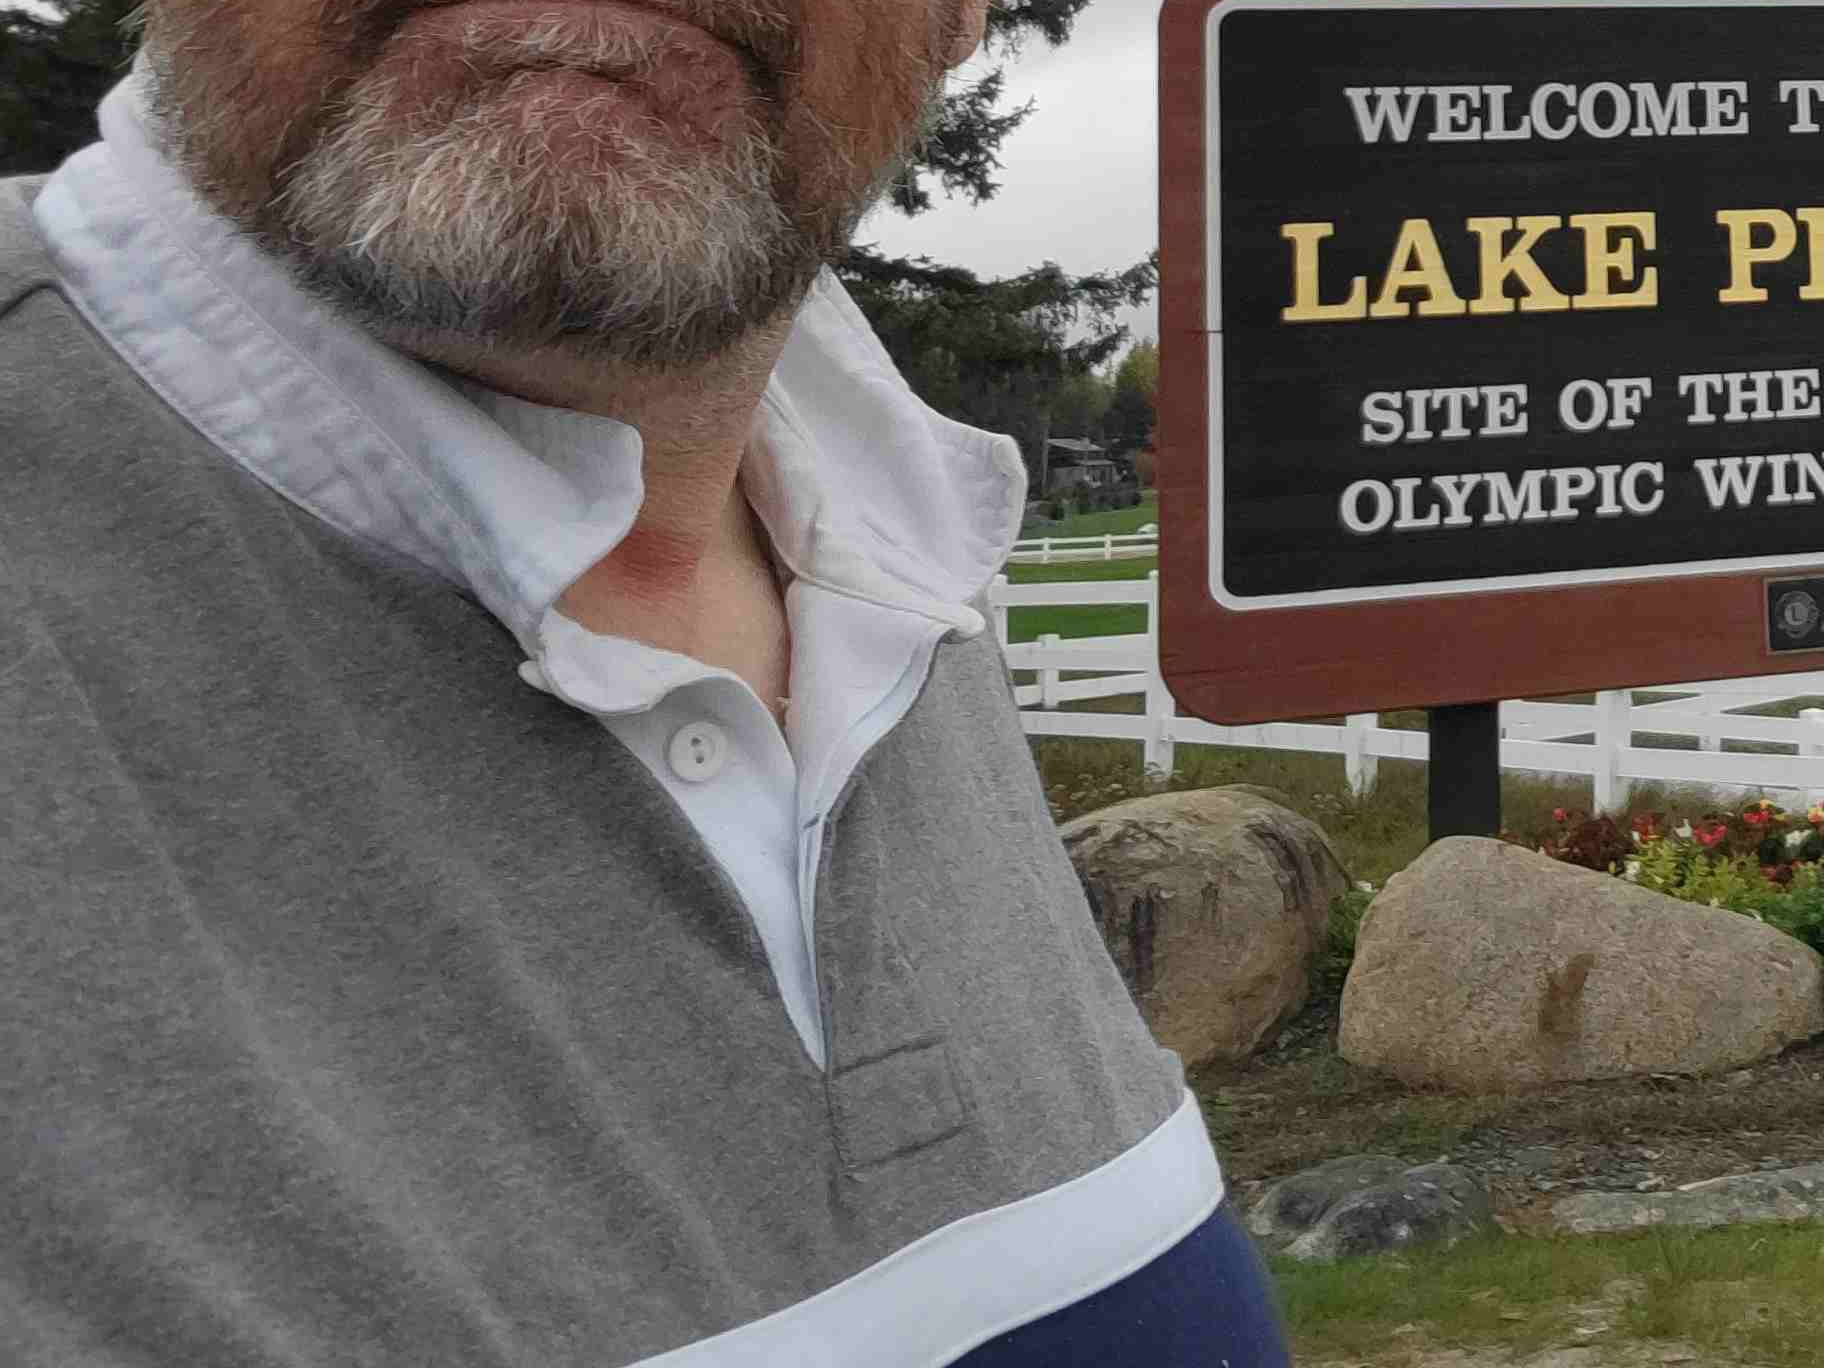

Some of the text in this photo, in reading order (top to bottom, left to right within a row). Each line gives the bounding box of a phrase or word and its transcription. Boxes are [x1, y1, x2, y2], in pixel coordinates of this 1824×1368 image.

[1345, 81, 1749, 143] WELCOME
[1280, 211, 1659, 322] LAKE
[1362, 384, 1529, 444] SITE
[1558, 377, 1652, 431] OF
[1678, 368, 1822, 425] THE
[1339, 461, 1665, 533] OLYMPIC
